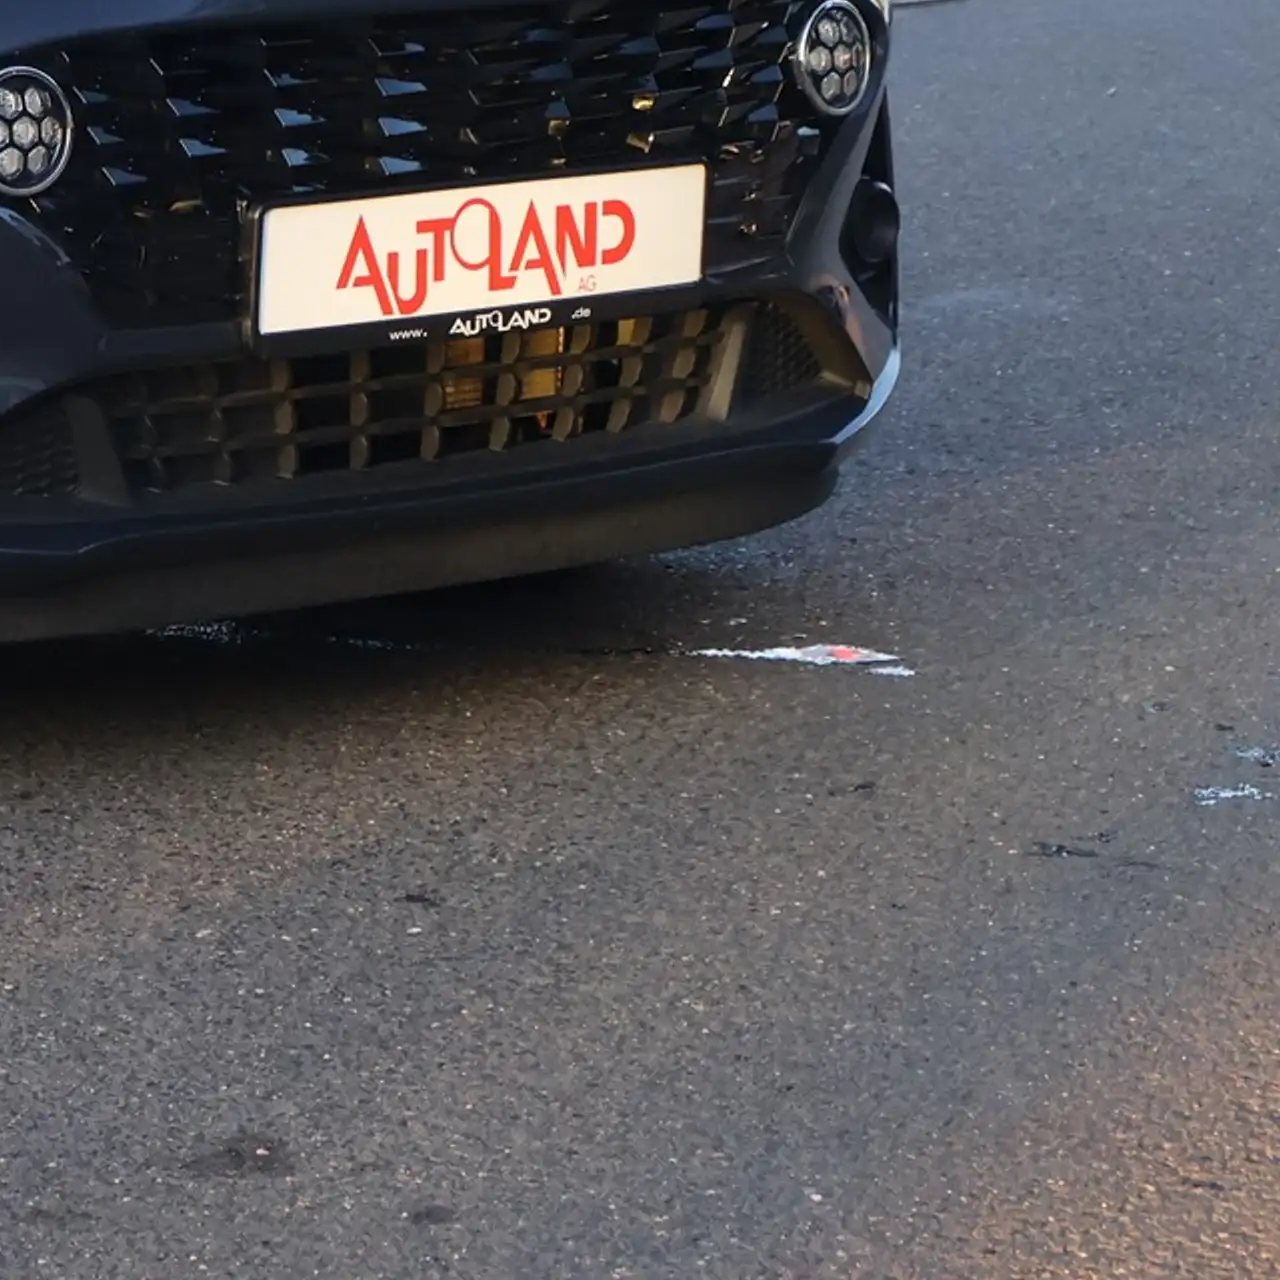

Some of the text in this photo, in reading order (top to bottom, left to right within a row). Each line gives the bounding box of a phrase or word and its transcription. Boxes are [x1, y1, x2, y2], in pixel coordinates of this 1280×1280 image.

[336, 197, 637, 316] AUTOLAND
[576, 274, 598, 293] AG
[389, 329, 428, 341] www.
[571, 306, 592, 320] .de
